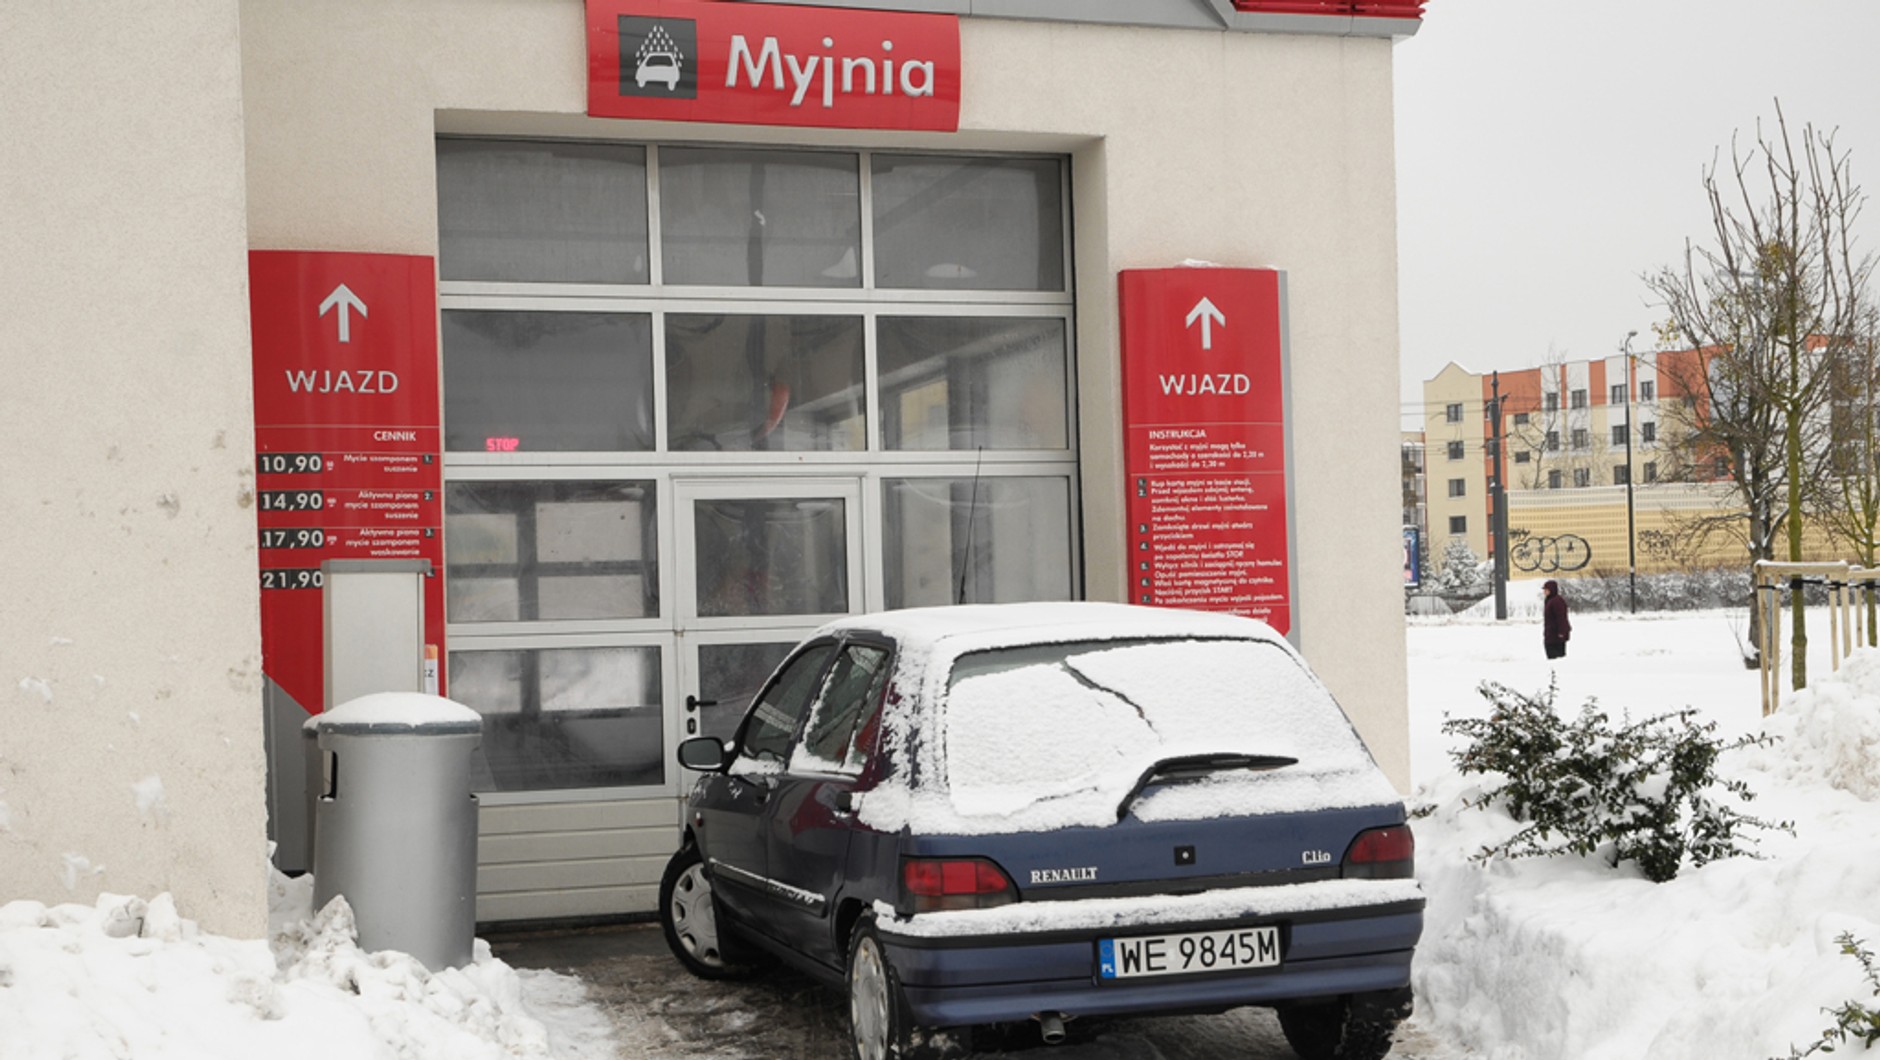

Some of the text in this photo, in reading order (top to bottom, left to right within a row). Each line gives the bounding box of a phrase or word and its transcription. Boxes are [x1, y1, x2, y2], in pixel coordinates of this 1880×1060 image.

[725, 34, 934, 108] Myjnia
[285, 370, 399, 394] WJAZD
[1159, 373, 1251, 396] WJAZD
[373, 430, 417, 442] CENNIK
[1149, 429, 1207, 439] INSTRUKCJA
[486, 437, 519, 451] STOP
[1190, 443, 1208, 451] myjni
[1230, 442, 1246, 450] tylko
[343, 455, 367, 463] Mycie
[370, 455, 418, 463] szamponem
[1149, 452, 1189, 460] samochody
[262, 455, 322, 474] 10,90
[383, 464, 418, 473] suszenie
[1151, 480, 1165, 488] Kup
[1186, 479, 1205, 487] myjni
[358, 490, 433, 500] Aktywna piana 2.
[1151, 487, 1170, 495] Przed
[262, 492, 323, 511] 14,90
[344, 502, 369, 511] mycie
[371, 502, 419, 510] szamponem
[385, 511, 419, 519] suszenie
[1212, 522, 1229, 530] myjni
[359, 528, 394, 537] Aktywna
[396, 528, 420, 537] piana
[262, 530, 324, 549] 17,90
[345, 539, 370, 547] mycie
[372, 538, 420, 547] szamponem
[1188, 542, 1207, 550] myjni
[370, 547, 420, 556] woskowanie
[262, 570, 324, 589] 21,90
[1302, 850, 1331, 865] Clio
[1030, 867, 1098, 884] RENAULT
[1120, 929, 1277, 974] WE 9845M
[1101, 963, 1113, 973] PL
